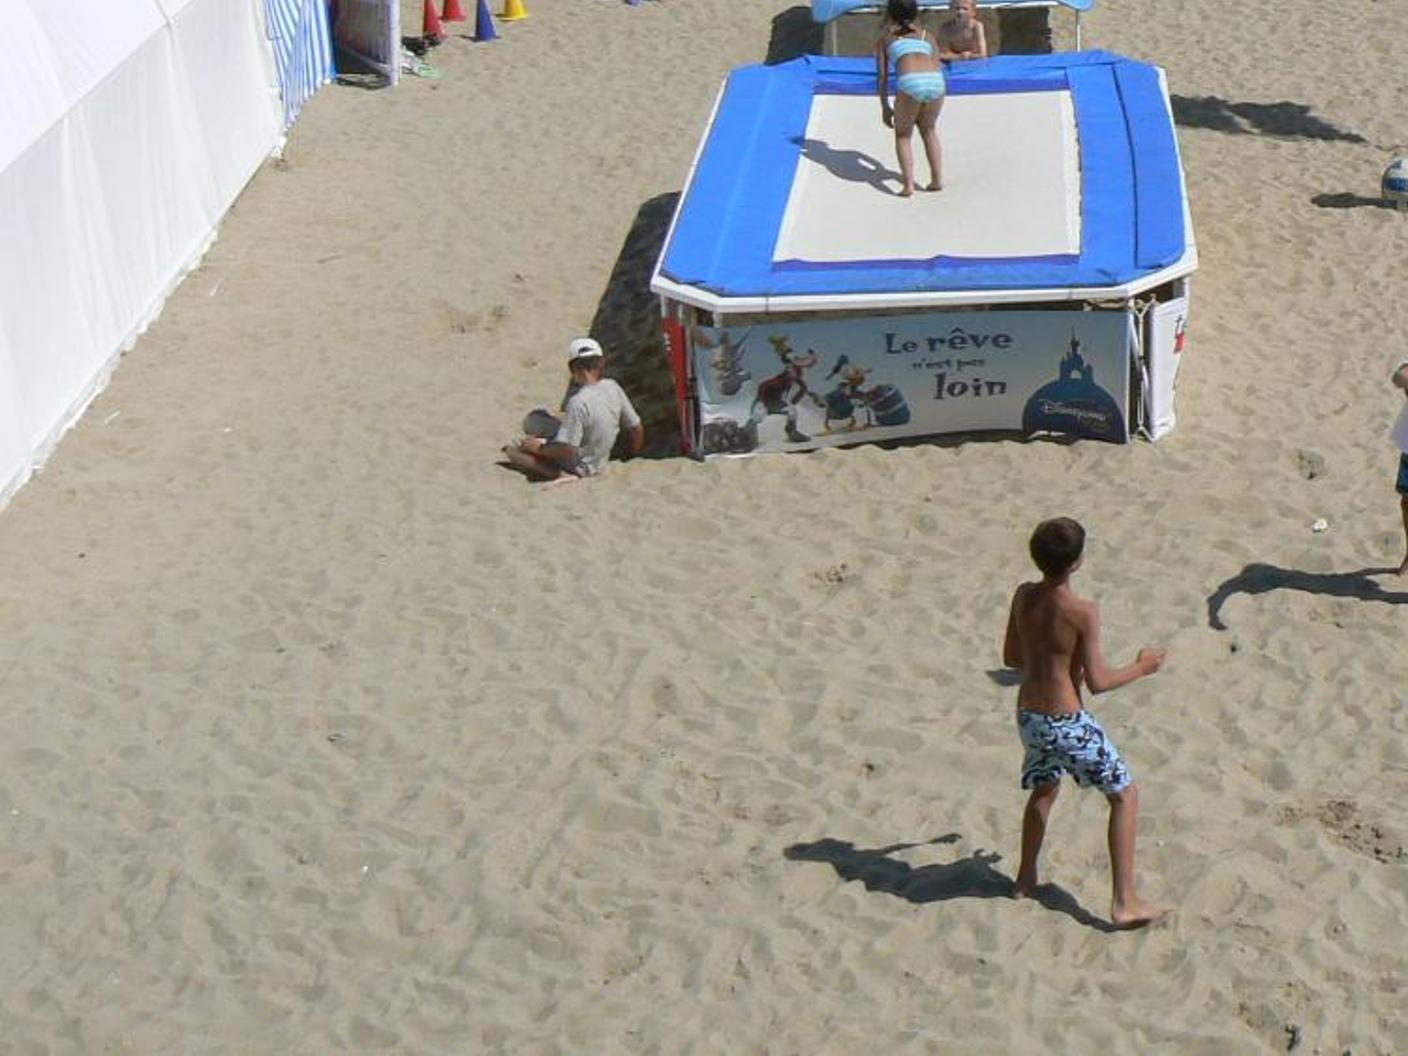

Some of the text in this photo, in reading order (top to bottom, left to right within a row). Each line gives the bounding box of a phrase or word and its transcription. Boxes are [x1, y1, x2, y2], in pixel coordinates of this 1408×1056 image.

[884, 326, 1013, 355] Le rêve
[932, 371, 1008, 400] loin
